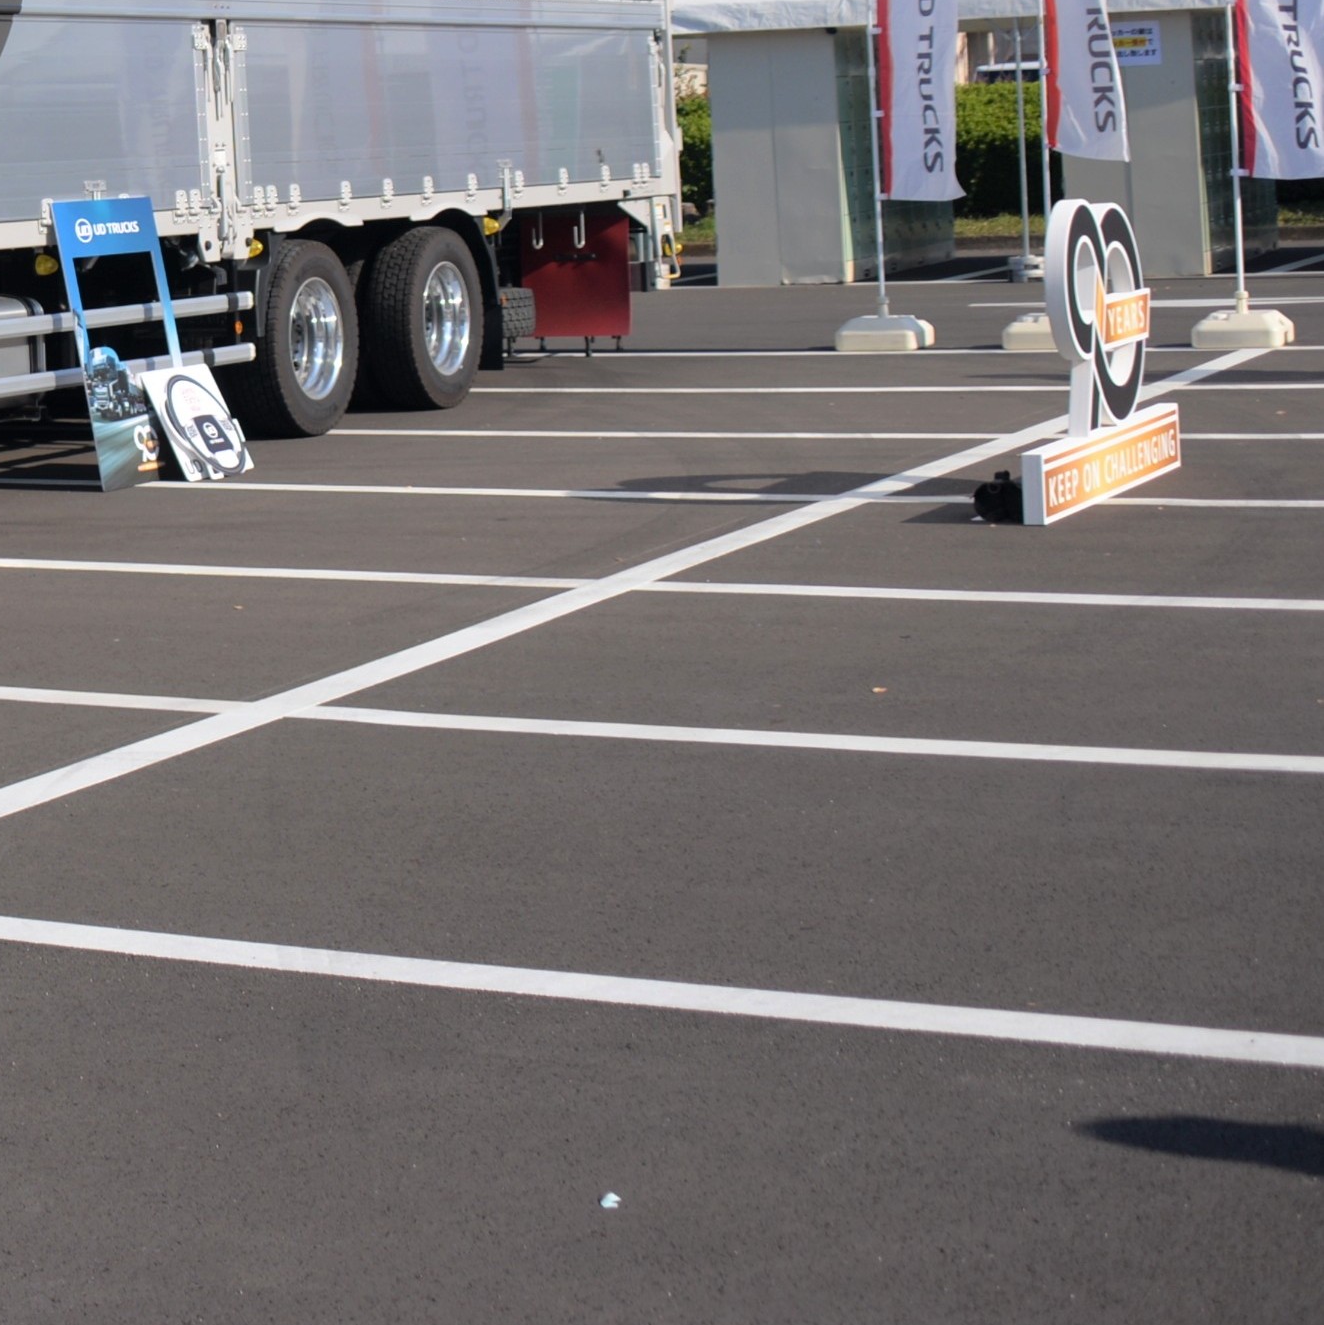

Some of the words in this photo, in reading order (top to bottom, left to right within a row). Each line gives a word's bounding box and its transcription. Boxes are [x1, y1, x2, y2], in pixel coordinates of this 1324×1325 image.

[916, 25, 944, 174] TRUCKS
[93, 220, 107, 236] UD
[107, 220, 140, 235] TRUCKS
[1106, 299, 1145, 337] YEARS
[1048, 469, 1080, 508] KEEP
[1082, 460, 1101, 490] ON
[1103, 429, 1176, 483] CHALLENGING
